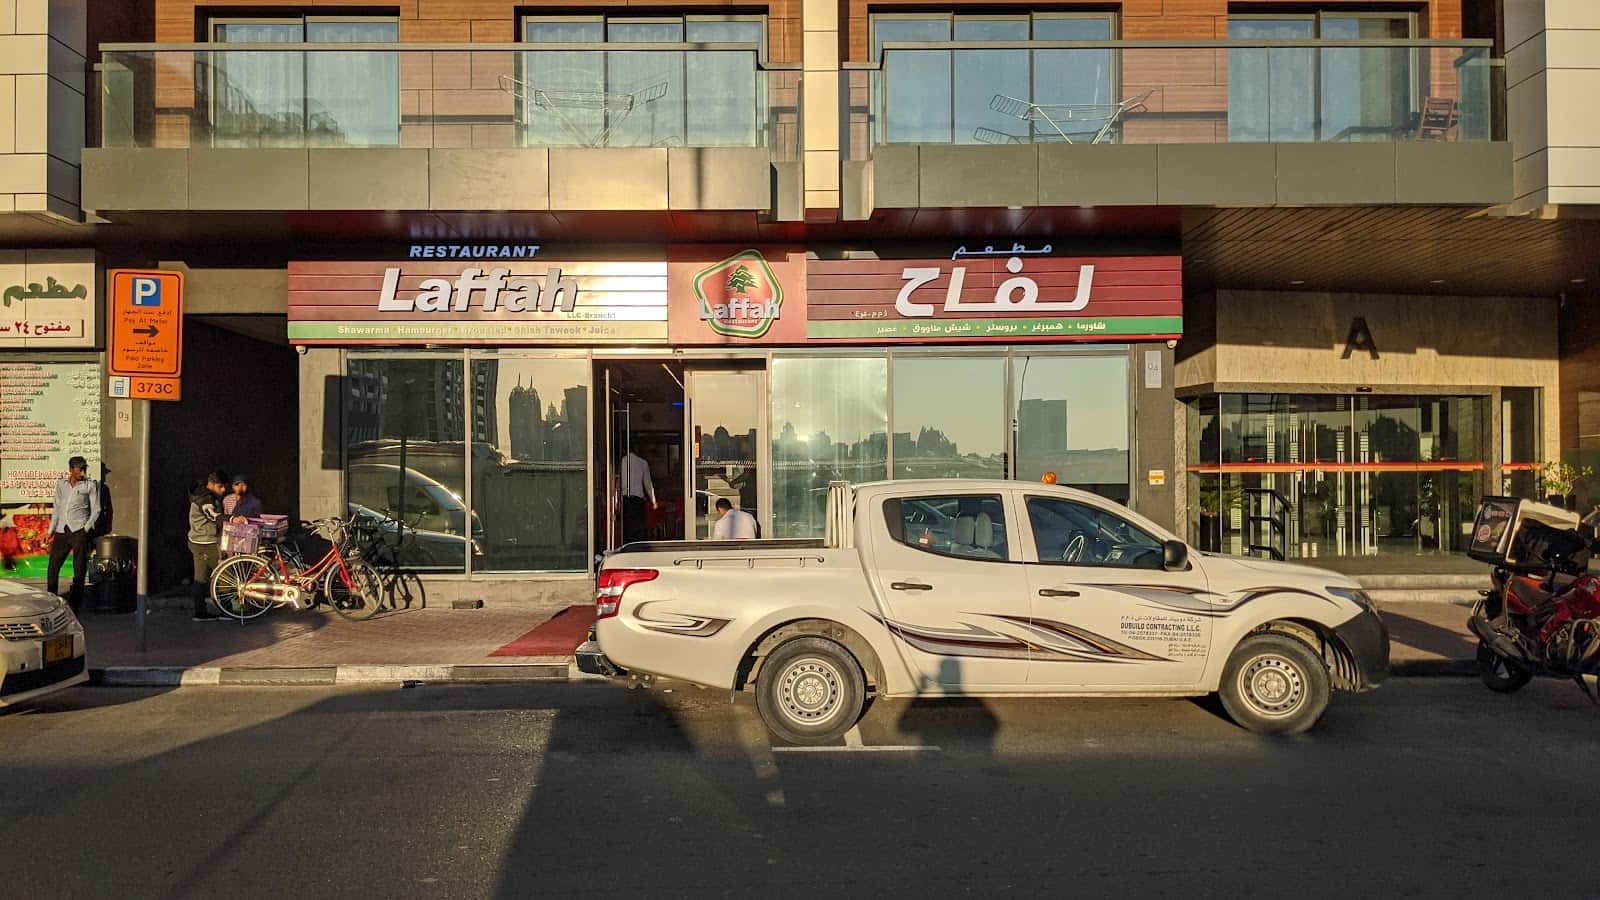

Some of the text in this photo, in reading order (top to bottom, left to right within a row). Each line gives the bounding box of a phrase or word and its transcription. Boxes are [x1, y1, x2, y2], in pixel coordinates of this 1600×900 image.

[409, 245, 541, 258] RESTAURANT
[952, 243, 1053, 260] مطعم
[3, 276, 88, 308] مطعم
[135, 278, 157, 305] P
[378, 267, 579, 313] Laffah
[894, 256, 1096, 317] لفاح
[700, 297, 780, 320] Laffah
[34, 320, 71, 335] مفتوح
[1341, 316, 1380, 360] A
[137, 382, 173, 394] 373C
[1120, 622, 1145, 630] DUBUILD
[1145, 623, 1185, 632] CONTRACTING
